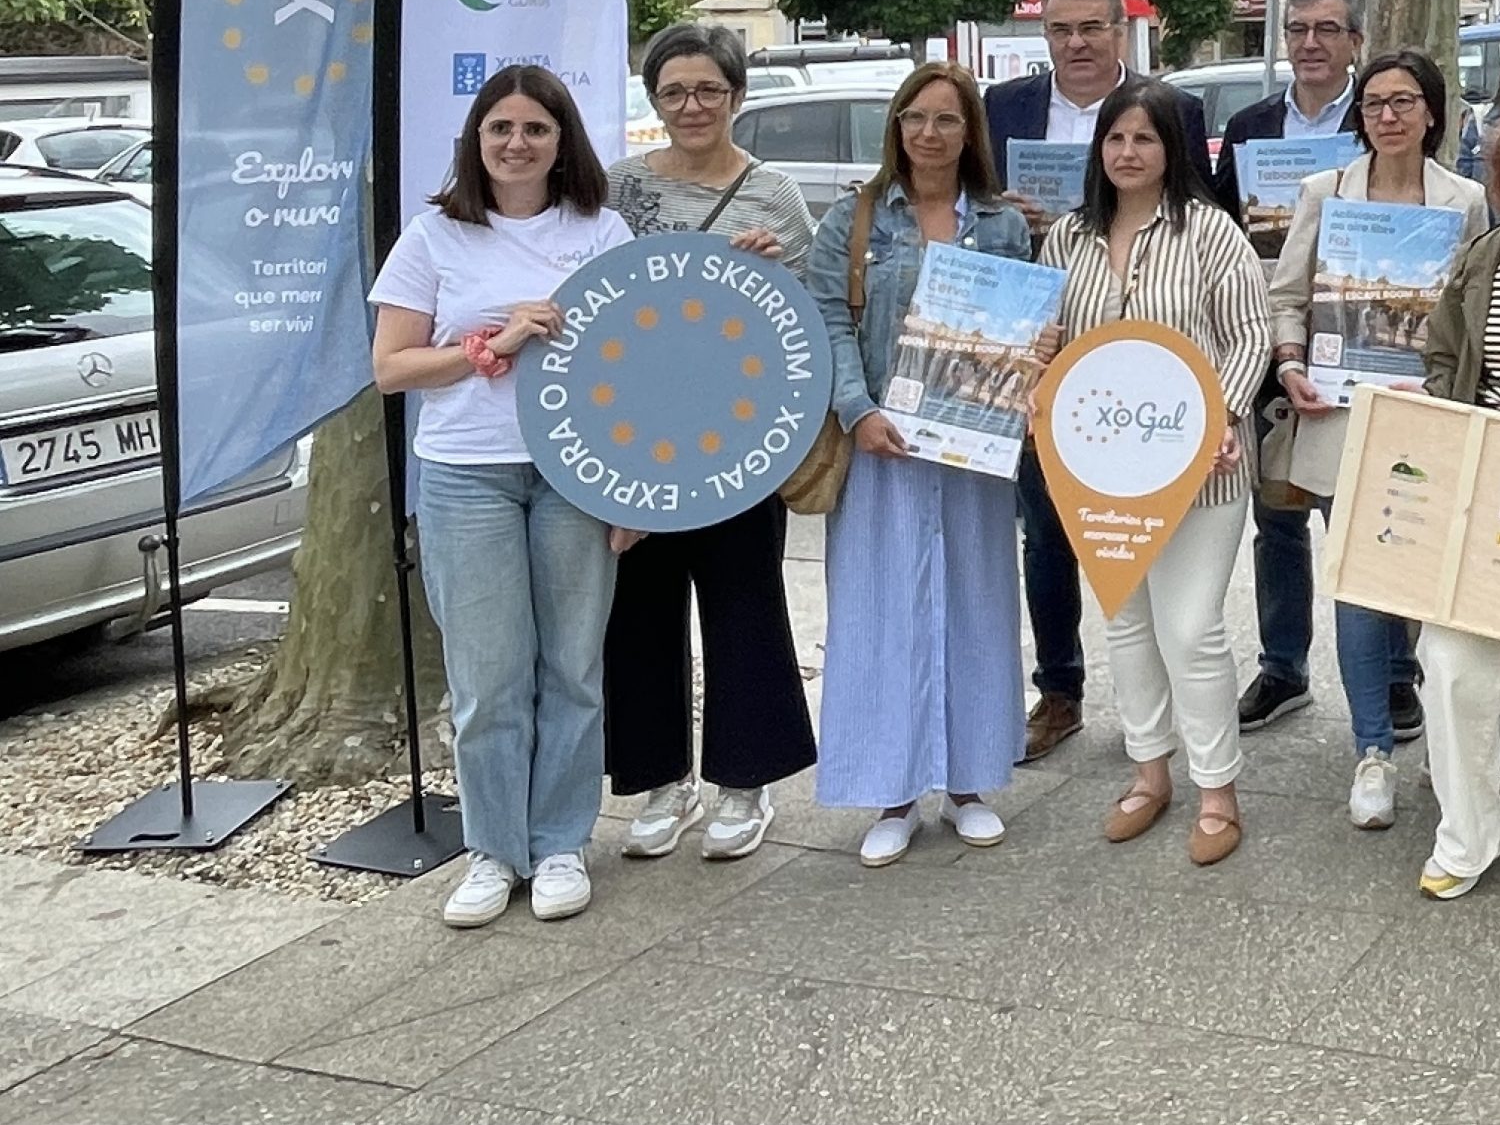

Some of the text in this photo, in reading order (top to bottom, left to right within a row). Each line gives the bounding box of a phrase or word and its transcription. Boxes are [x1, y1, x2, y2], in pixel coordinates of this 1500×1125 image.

[245, 207, 269, 227] o
[234, 290, 276, 309] que
[249, 318, 280, 333] ser
[646, 252, 813, 381] BY SKEIRRUM
[539, 276, 679, 511] EXPLORA O RURAL
[17, 418, 157, 475] 2745 MH
[704, 405, 805, 499] XOGAL
